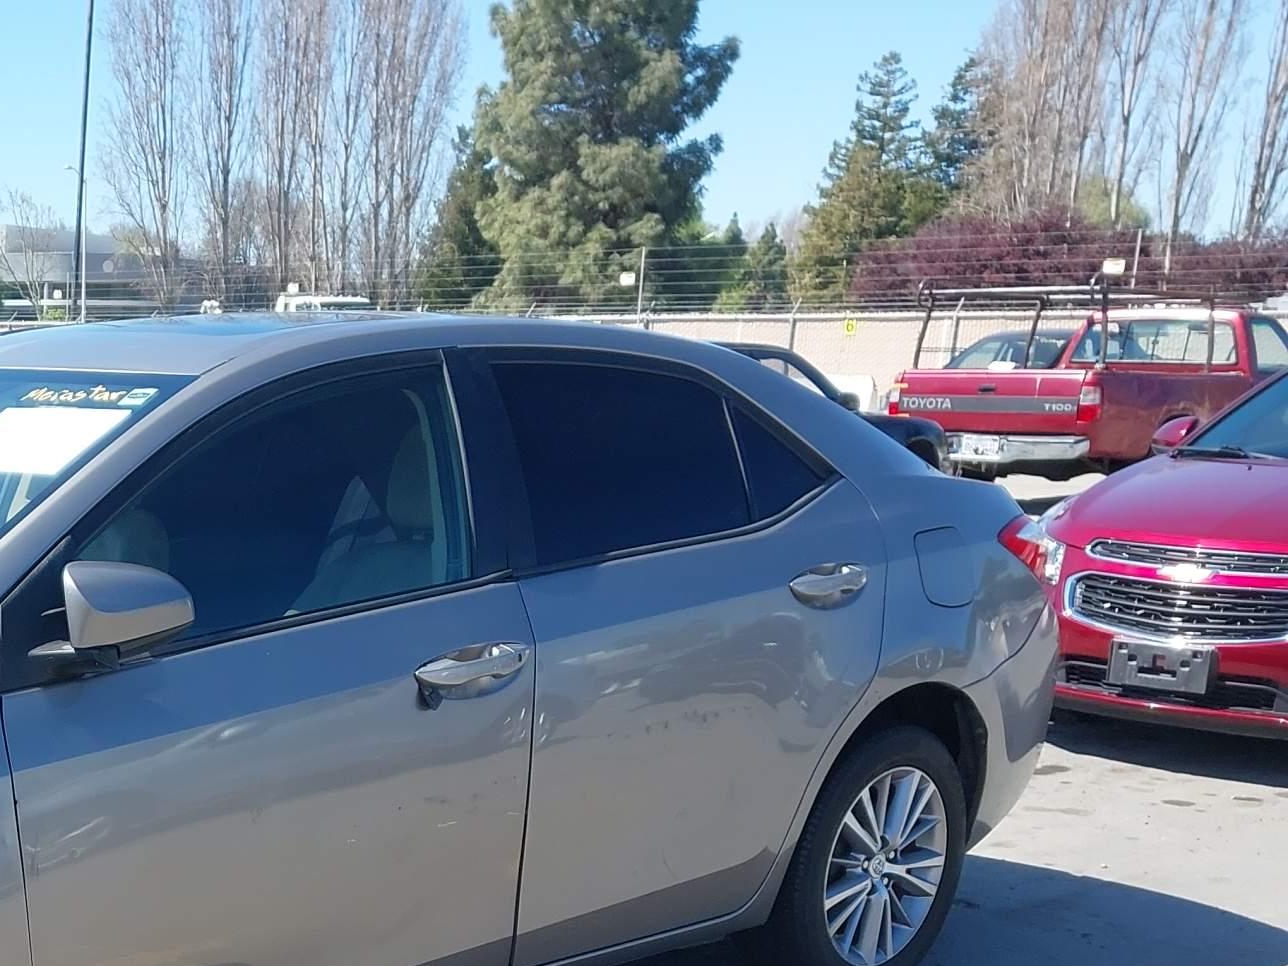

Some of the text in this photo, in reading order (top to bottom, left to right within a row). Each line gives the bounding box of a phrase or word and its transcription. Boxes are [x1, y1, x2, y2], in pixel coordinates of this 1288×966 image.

[846, 318, 854, 333] 6
[902, 397, 952, 411] TOYOTA
[1044, 402, 1072, 412] T100
